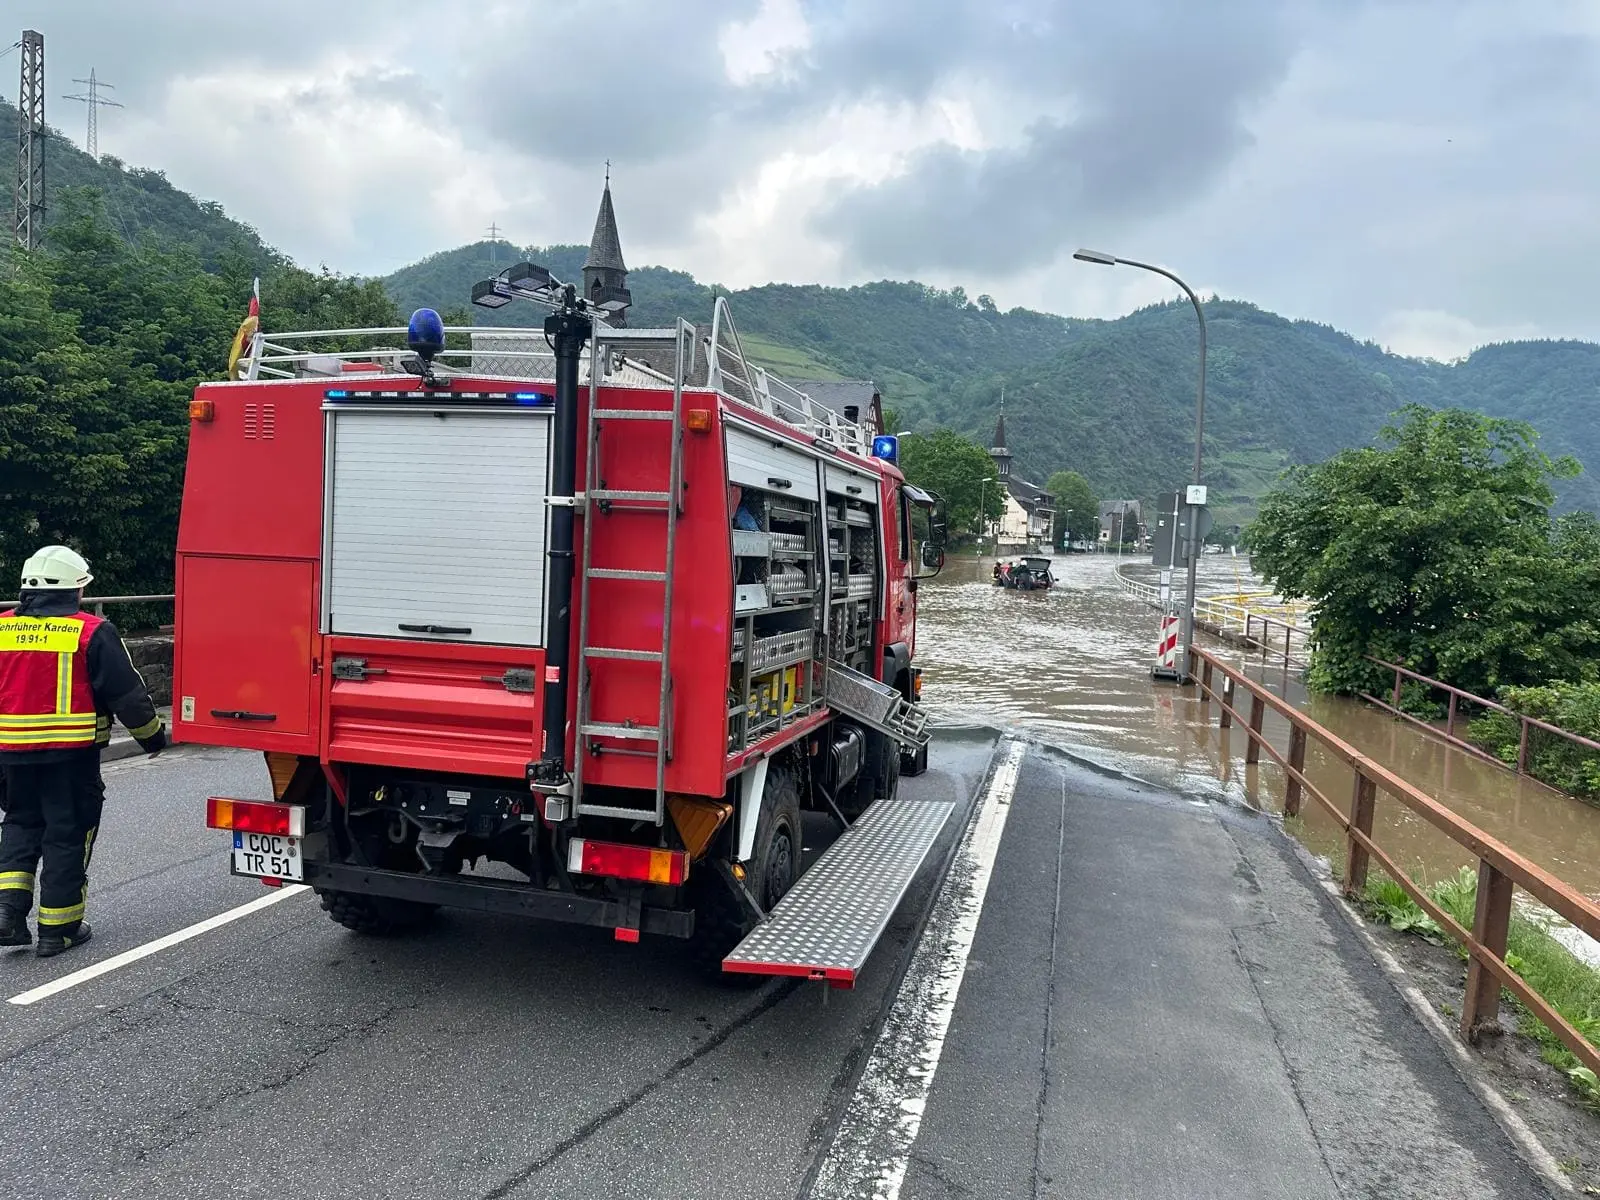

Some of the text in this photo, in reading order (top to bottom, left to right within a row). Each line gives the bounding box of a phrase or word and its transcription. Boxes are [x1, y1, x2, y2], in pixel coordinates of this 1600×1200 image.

[0, 622, 80, 633] ehrführer Karden
[249, 833, 283, 855] COC
[243, 853, 292, 877] TR 51
